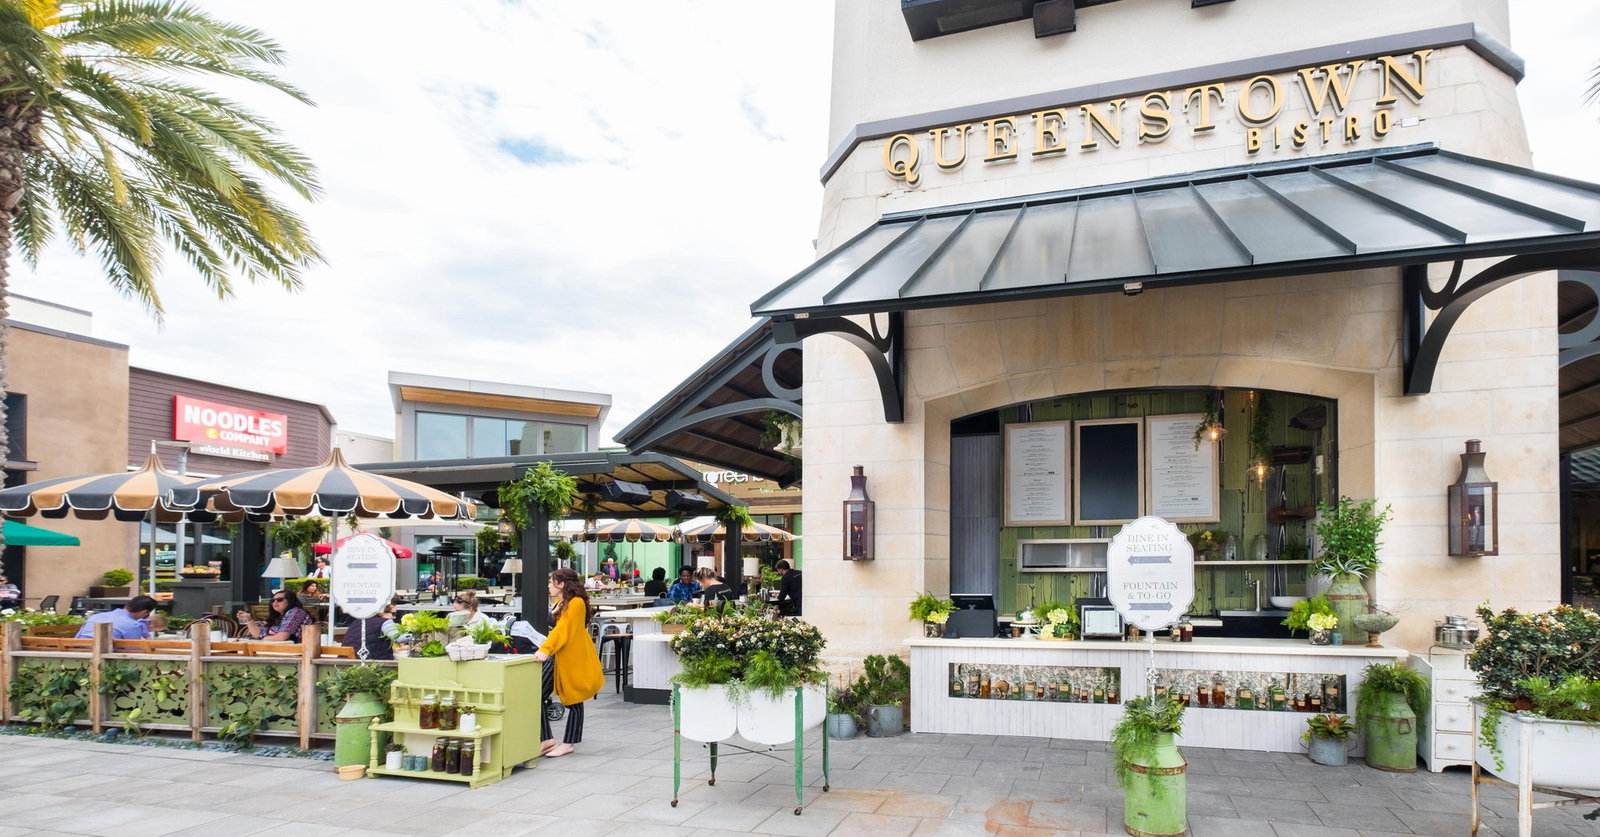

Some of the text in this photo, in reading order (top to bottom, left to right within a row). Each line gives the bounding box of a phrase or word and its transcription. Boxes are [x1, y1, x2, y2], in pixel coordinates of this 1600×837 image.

[882, 49, 1433, 187] QUEENSTOWN
[1247, 109, 1393, 156] BISTRO
[184, 405, 283, 437] NOODLES
[220, 430, 270, 446] COMPANY
[232, 448, 269, 460] Kitchen
[1128, 533, 1169, 543] DINE IN
[1126, 543, 1173, 553] SEATING
[343, 581, 383, 589] FOUNTAIN
[1123, 581, 1179, 591] FOUNTAIN
[1127, 592, 1172, 600] & TO-GO
